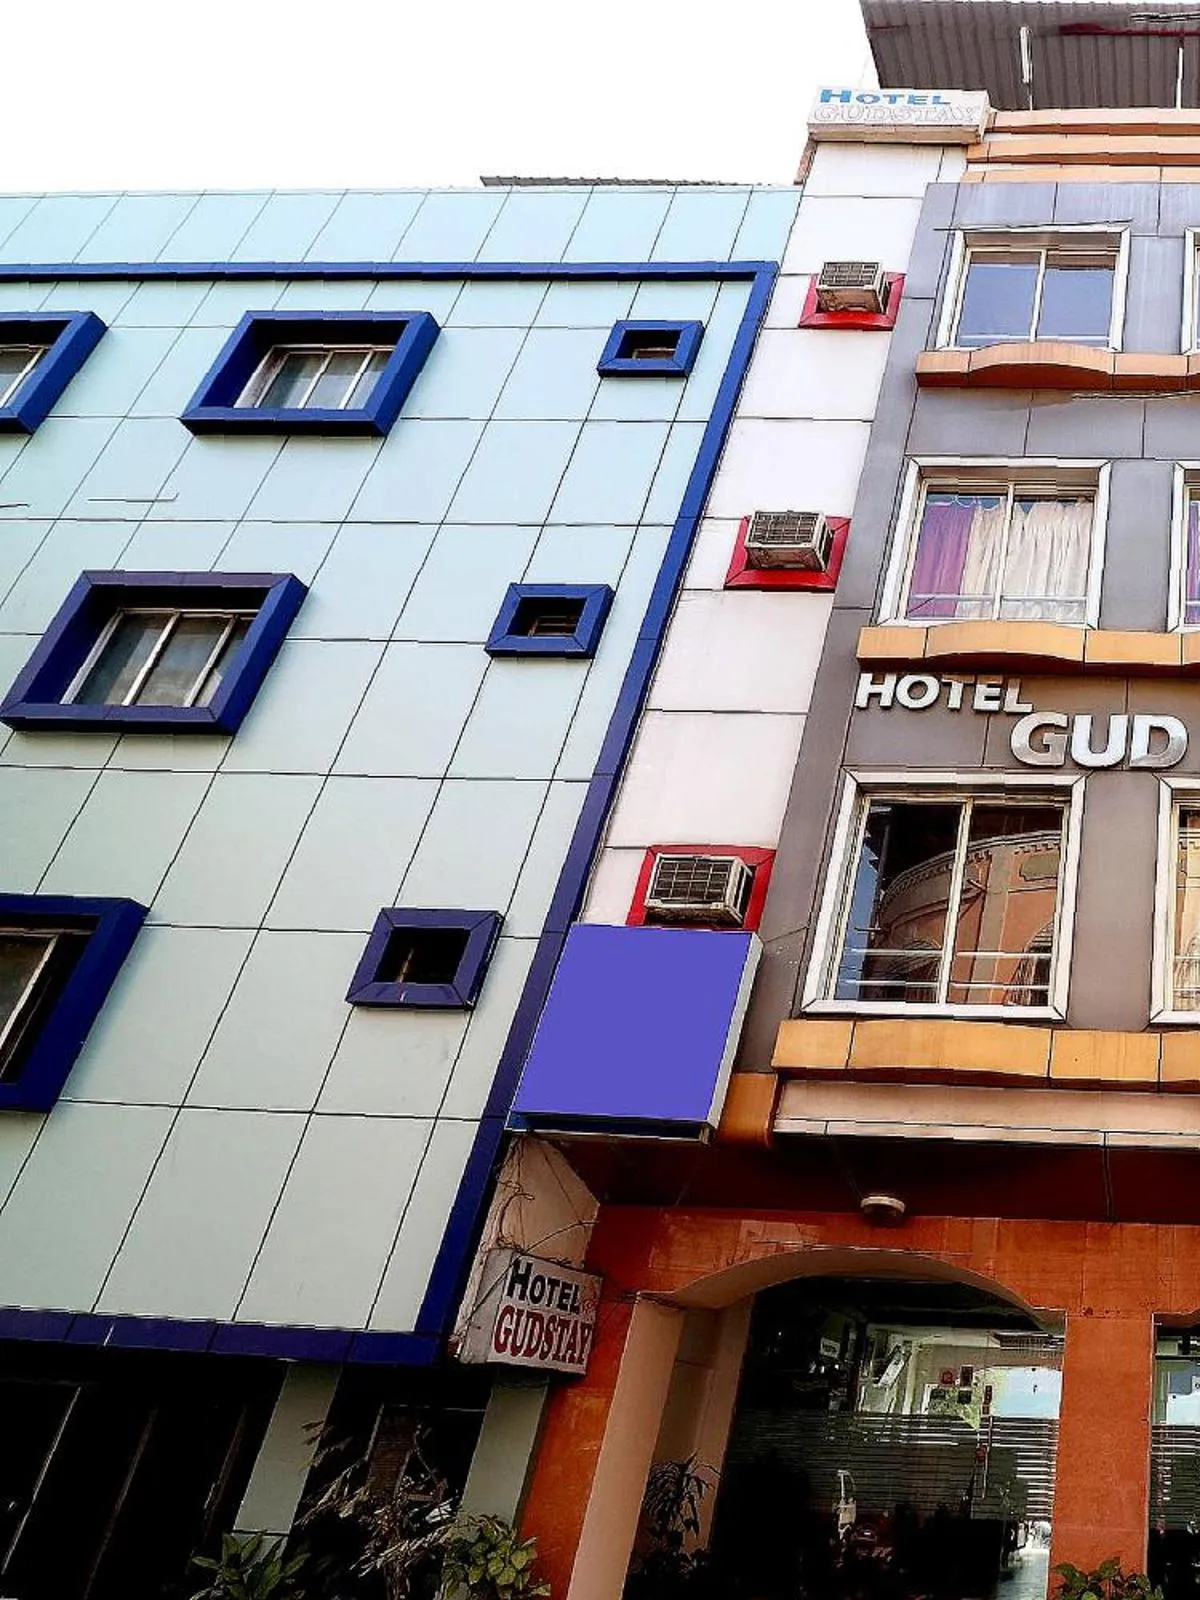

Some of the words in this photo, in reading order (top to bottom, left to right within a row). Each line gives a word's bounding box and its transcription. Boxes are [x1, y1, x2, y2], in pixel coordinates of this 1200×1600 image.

[814, 105, 982, 123] GUDSTAY
[820, 89, 951, 105] HOTEL
[853, 672, 1034, 713] HOTEL
[1009, 711, 1189, 768] GUD
[507, 1259, 580, 1315] HOTEL
[494, 1305, 593, 1364] GUDSTAY
